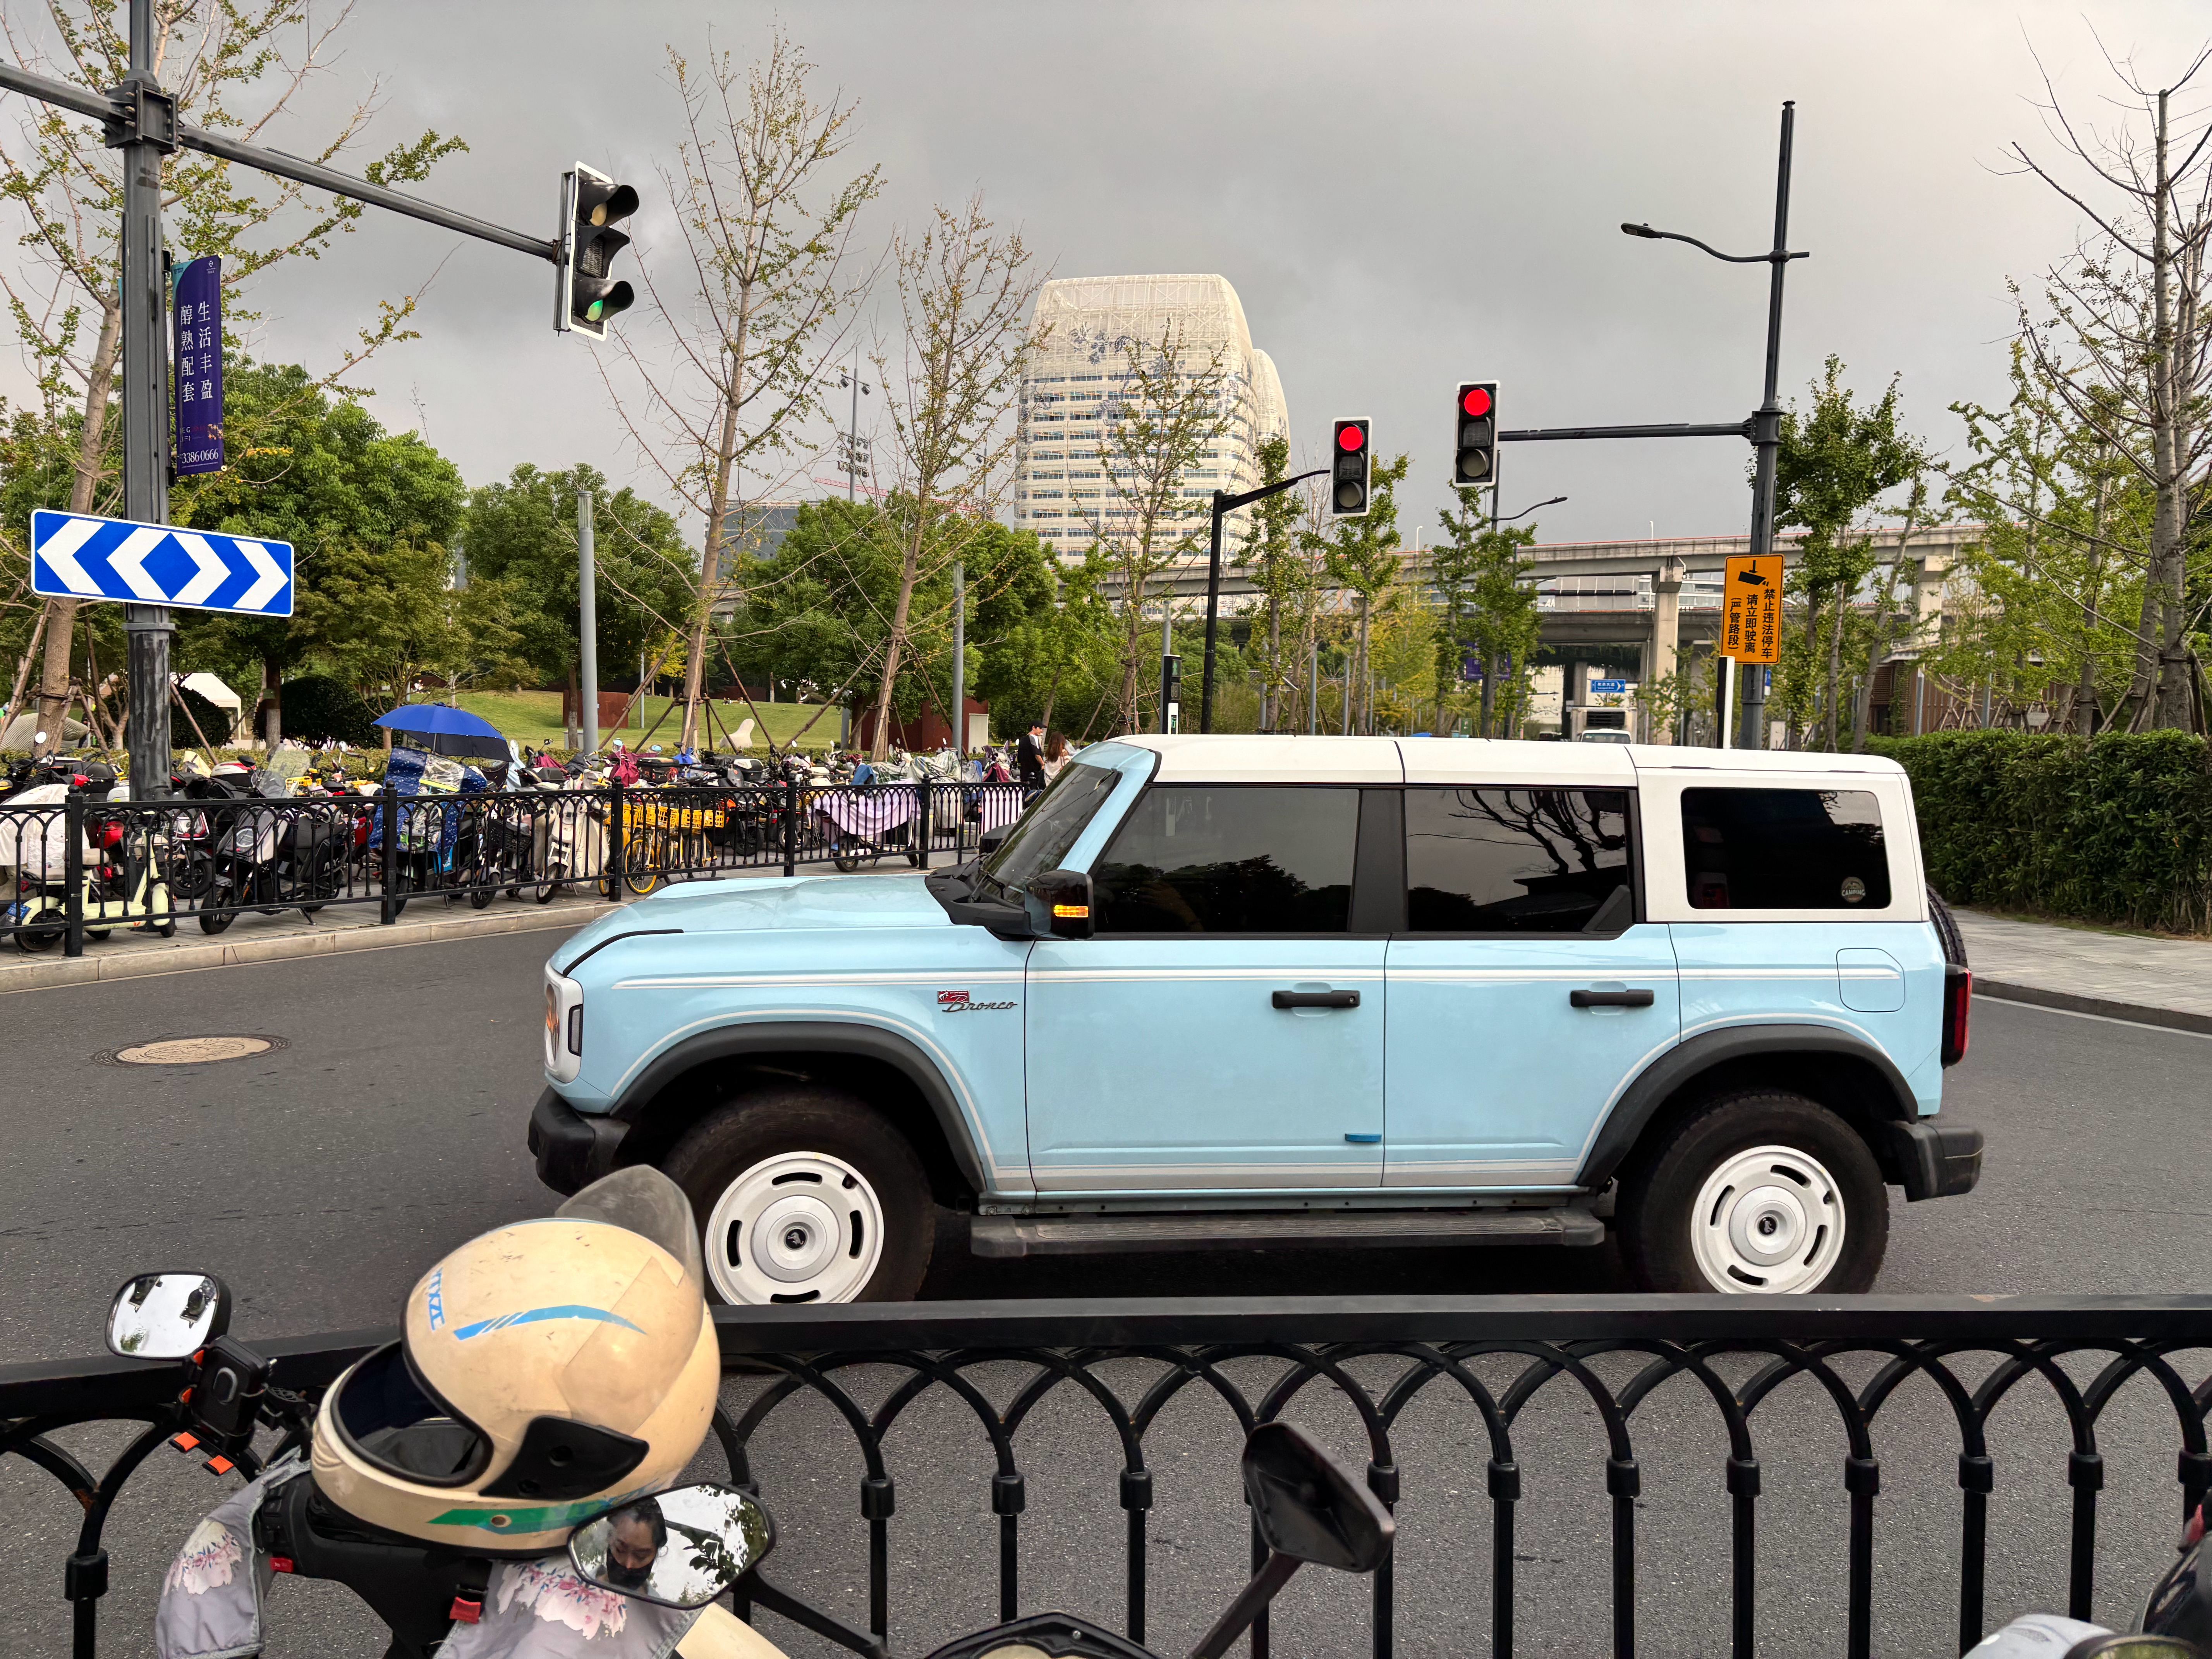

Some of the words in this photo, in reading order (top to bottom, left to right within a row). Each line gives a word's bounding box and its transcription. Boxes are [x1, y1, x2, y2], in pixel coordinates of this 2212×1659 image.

[180, 305, 194, 402] 醇熟配套
[198, 301, 213, 400] 生活丰盈
[1744, 594, 1758, 654] 请立即驶离
[1761, 588, 1776, 659] 禁止违法停车
[941, 994, 1018, 1012] Bronco
